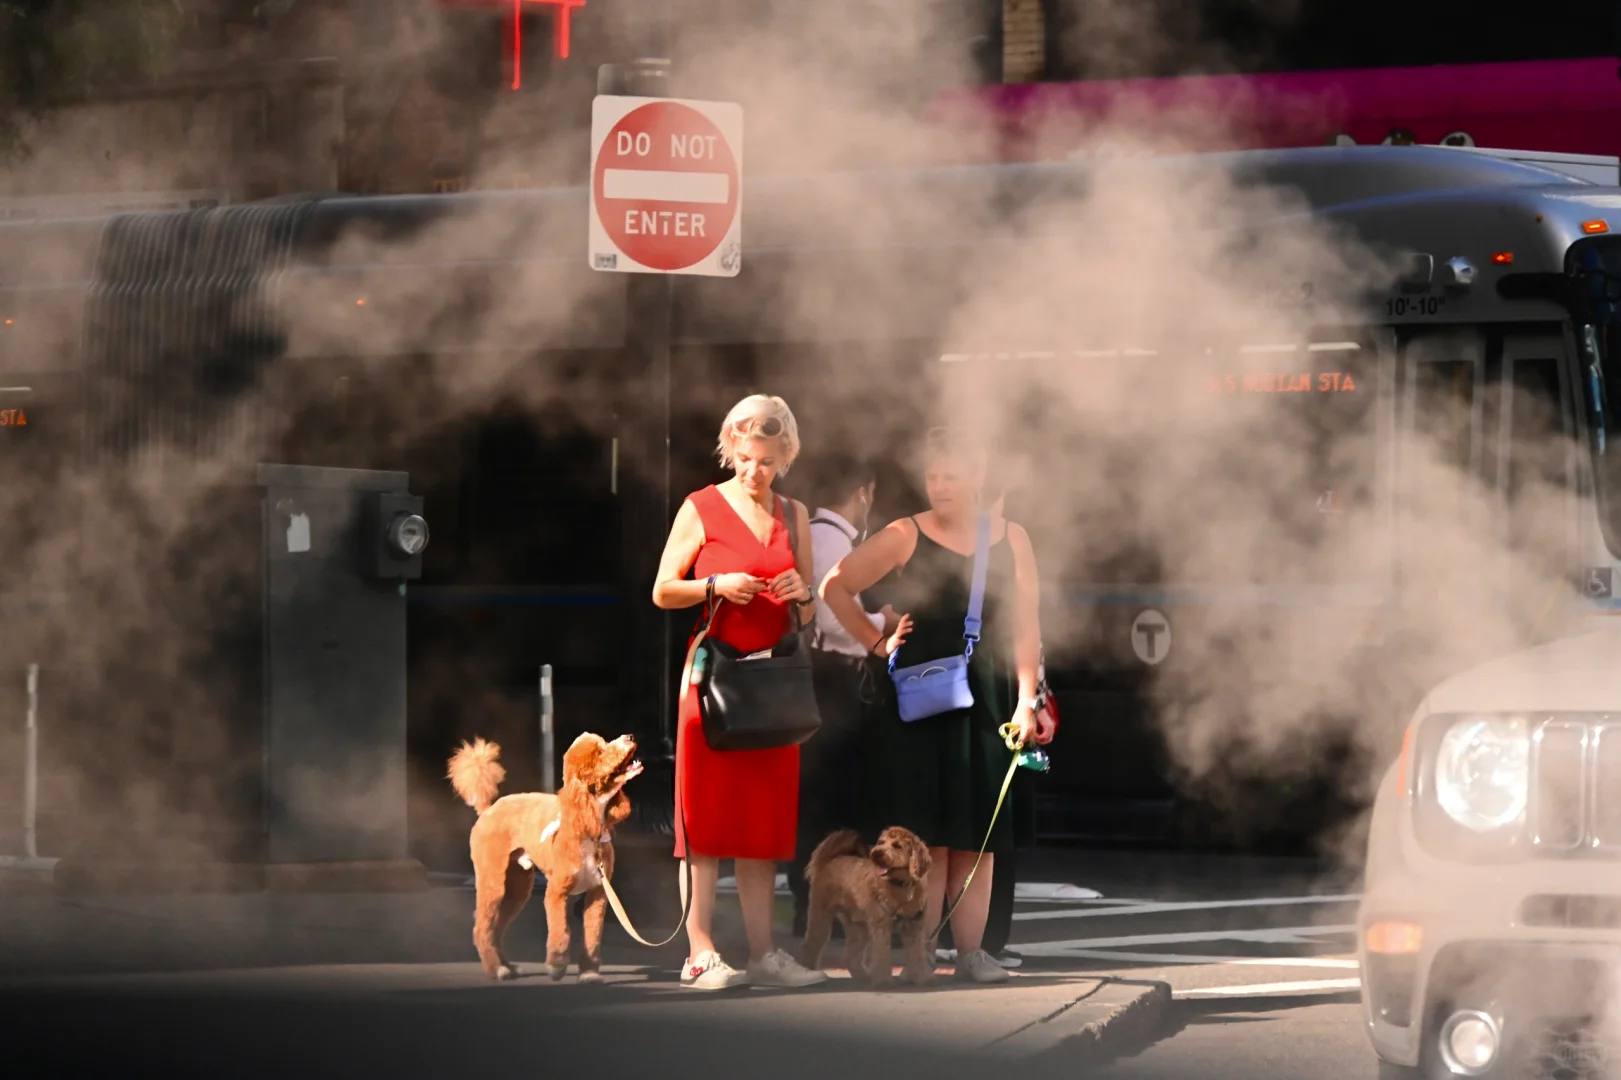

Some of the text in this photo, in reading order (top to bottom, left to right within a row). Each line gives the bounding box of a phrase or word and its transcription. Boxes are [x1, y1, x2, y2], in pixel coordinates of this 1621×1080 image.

[617, 131, 717, 160] DO NOT
[625, 210, 706, 237] ENTER
[1385, 296, 1446, 316] 10'-10"
[1317, 372, 1356, 392] STA
[0, 408, 27, 425] STA
[1136, 622, 1165, 659] T
